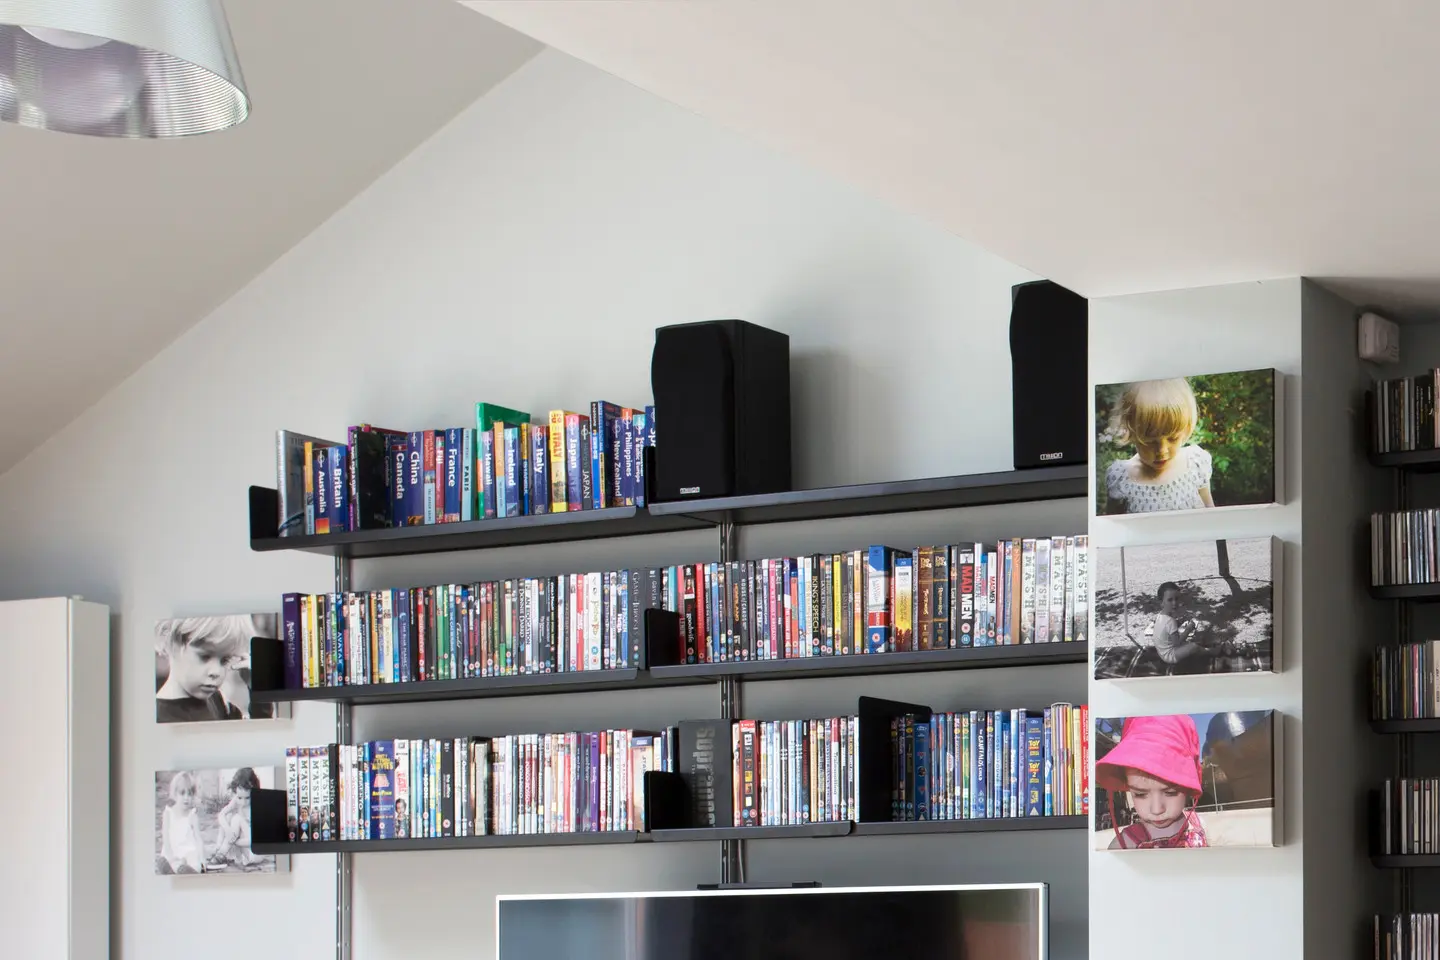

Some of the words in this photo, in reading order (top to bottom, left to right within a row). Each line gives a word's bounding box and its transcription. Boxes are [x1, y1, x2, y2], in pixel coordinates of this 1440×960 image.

[410, 451, 419, 484] China
[448, 448, 457, 487] France
[508, 449, 516, 486] Ireland
[534, 448, 544, 473] Italy
[569, 438, 577, 469] Japan
[624, 432, 632, 477] Philippines
[318, 470, 326, 513] Australia
[396, 453, 404, 499] Canada
[582, 469, 590, 499] JAPAN
[693, 727, 715, 825] Sopranos
